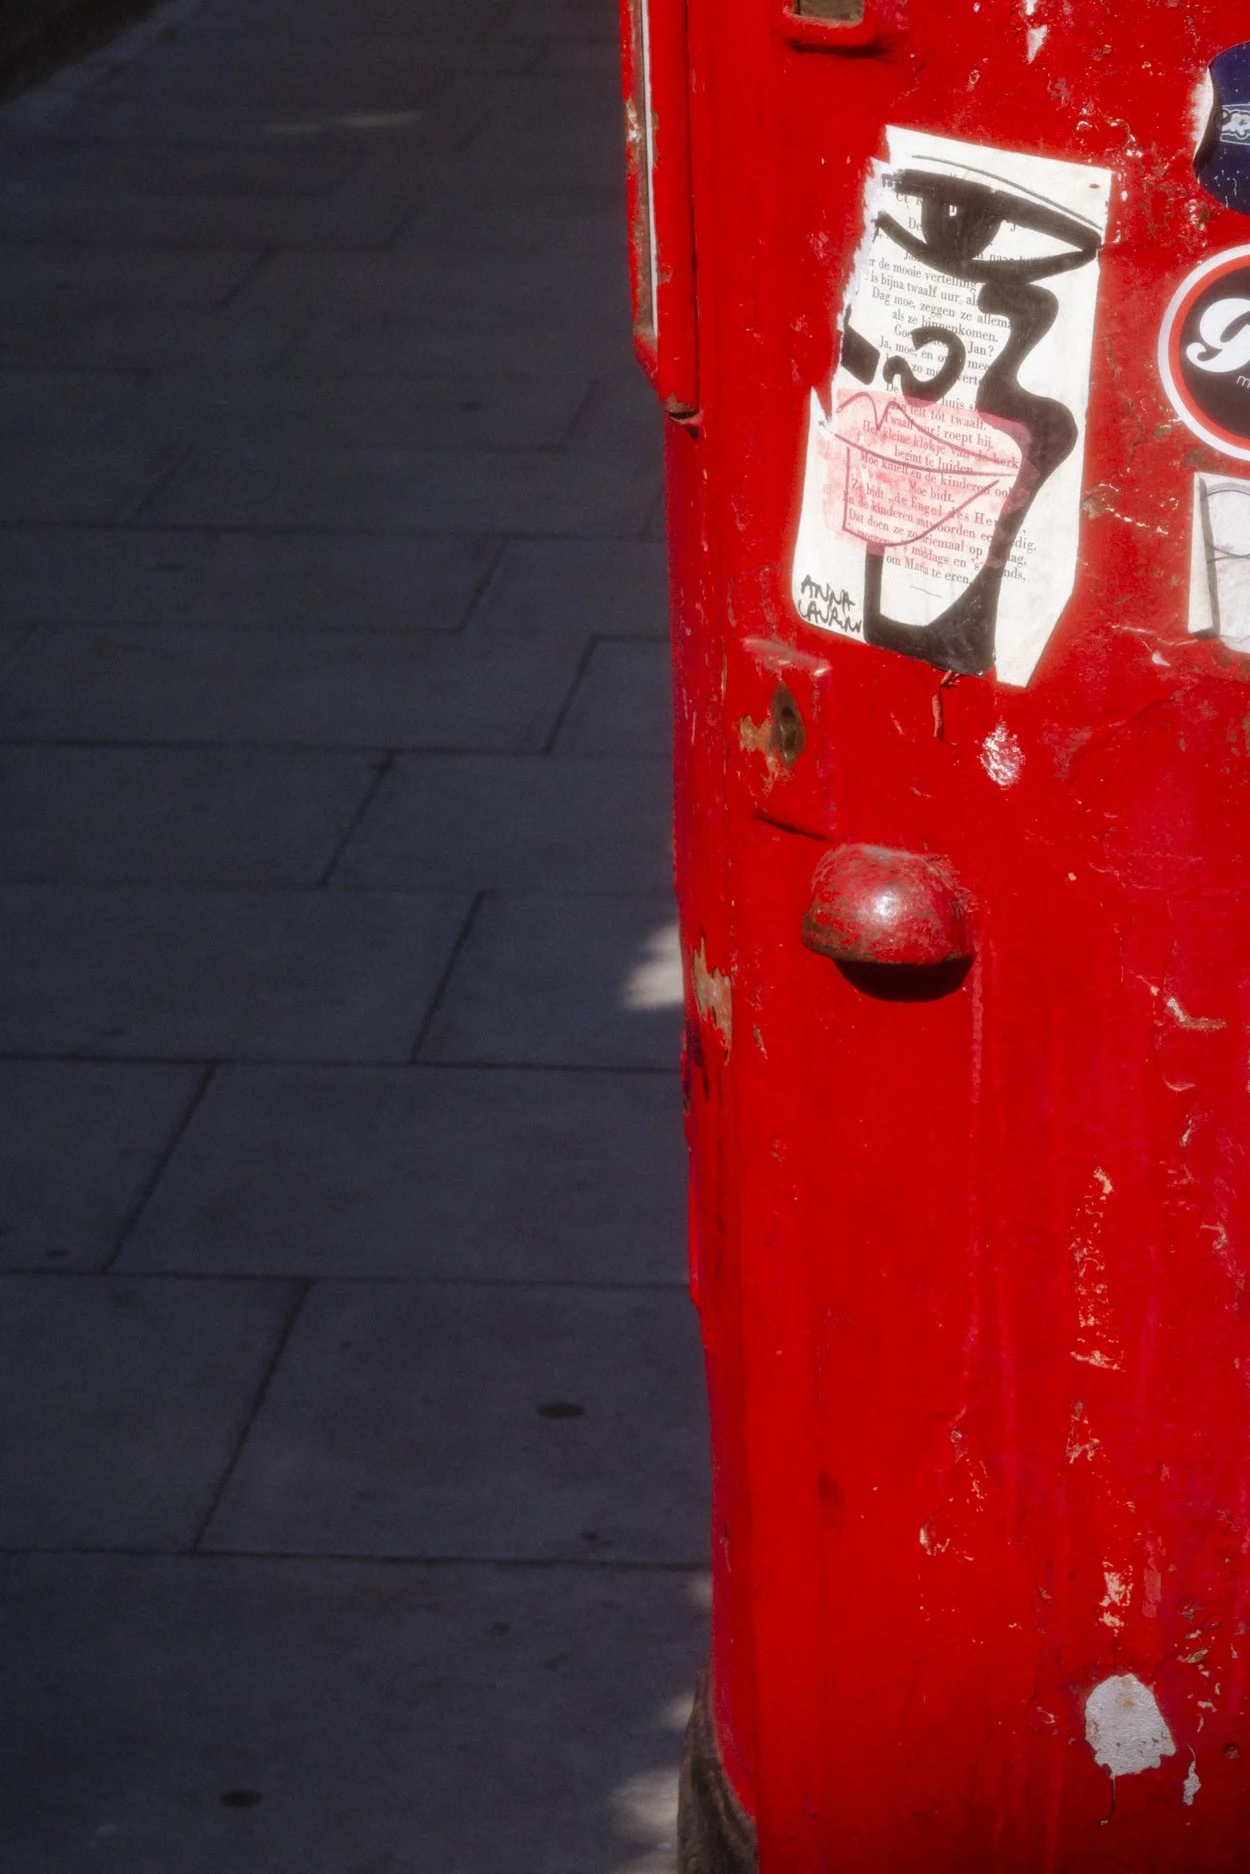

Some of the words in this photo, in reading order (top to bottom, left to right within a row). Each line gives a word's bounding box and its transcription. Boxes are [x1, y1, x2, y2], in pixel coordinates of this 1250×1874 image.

[879, 257, 890, 270] de
[893, 265, 922, 279] mooie
[881, 274, 904, 290] bijna
[907, 282, 938, 298] twaalf
[872, 286, 891, 306] Dag
[920, 302, 955, 320] zeggen
[960, 310, 972, 321] ze
[892, 309, 904, 321] als
[907, 314, 918, 324] ze
[944, 430, 973, 446] roept
[800, 574, 856, 614] ANNA
